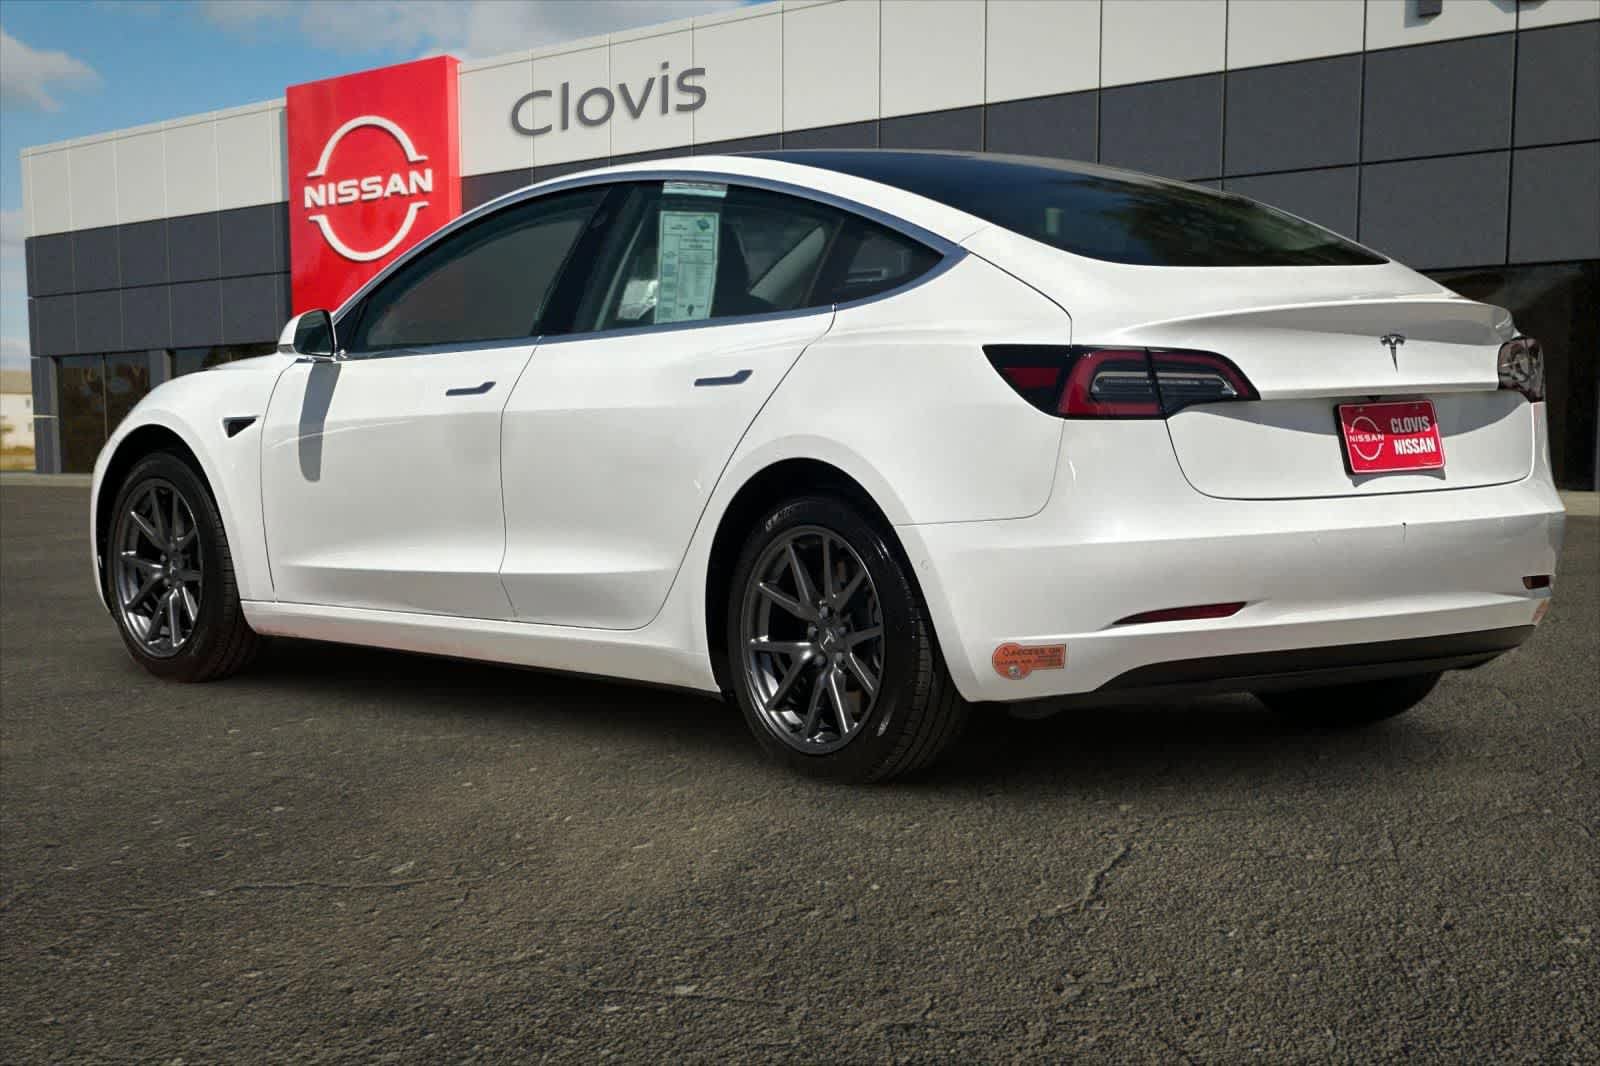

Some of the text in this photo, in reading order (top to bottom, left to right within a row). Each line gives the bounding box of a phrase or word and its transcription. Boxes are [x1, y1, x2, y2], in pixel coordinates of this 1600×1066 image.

[511, 62, 707, 136] Clovis
[304, 169, 432, 208] NISSAN
[1390, 416, 1430, 433] CLOVIS
[1349, 433, 1385, 442] NISSAN
[1393, 437, 1436, 455] NISSAN
